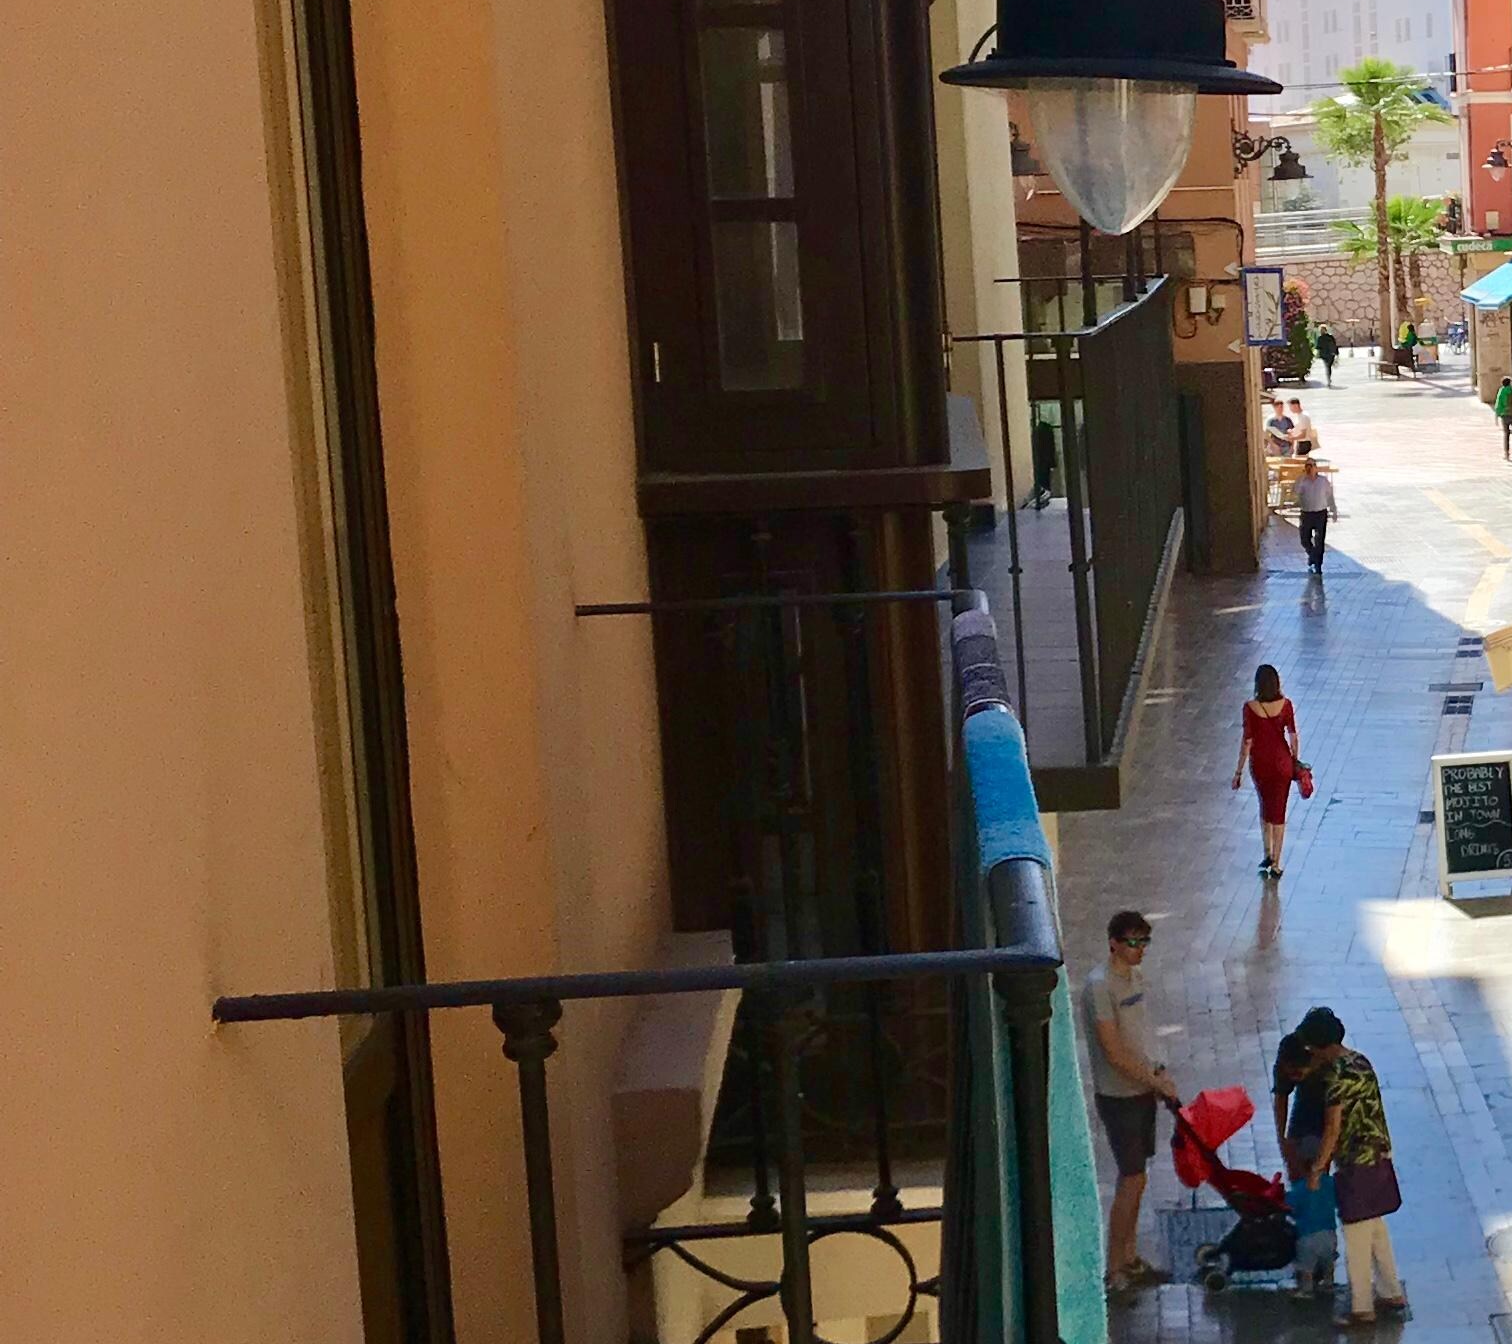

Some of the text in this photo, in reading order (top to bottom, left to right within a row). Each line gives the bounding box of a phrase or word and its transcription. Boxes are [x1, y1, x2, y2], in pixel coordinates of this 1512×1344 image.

[1442, 766, 1505, 783] PROBABLY
[1444, 781, 1492, 796] THE BEST
[1446, 796, 1499, 810] MOJITO
[1446, 811, 1463, 824] IN
